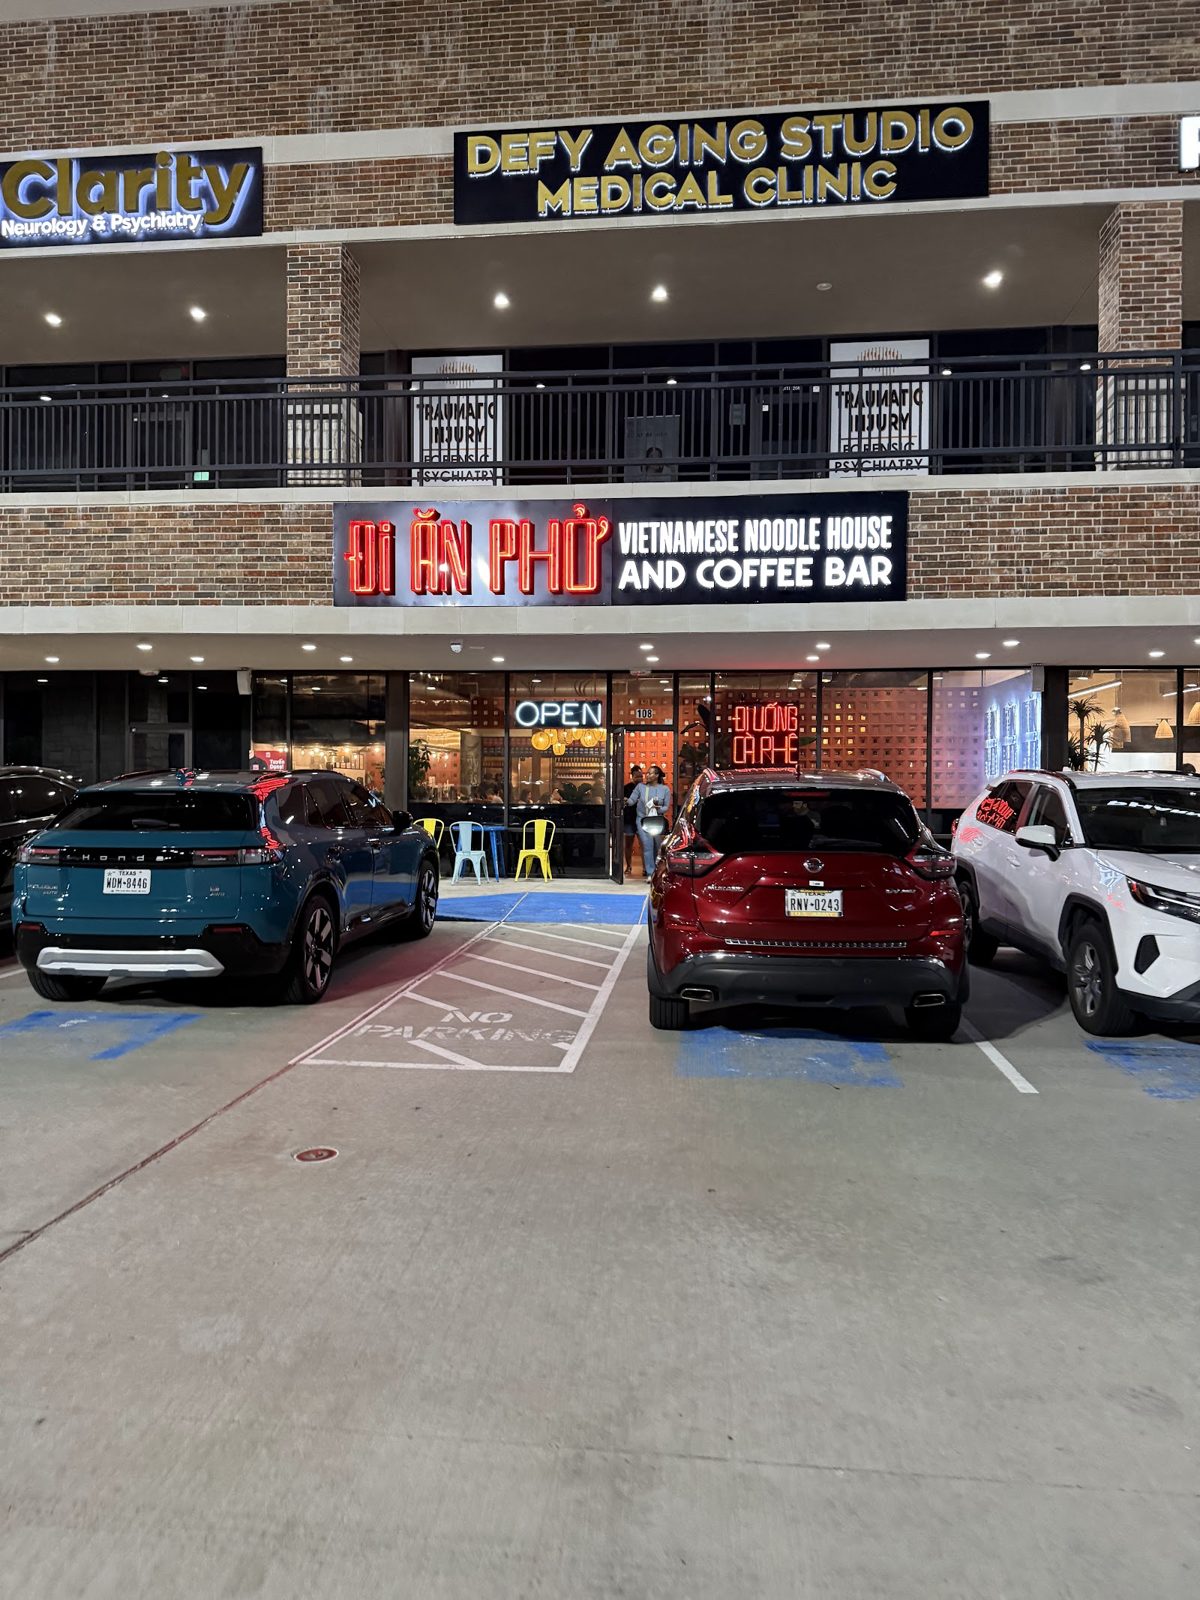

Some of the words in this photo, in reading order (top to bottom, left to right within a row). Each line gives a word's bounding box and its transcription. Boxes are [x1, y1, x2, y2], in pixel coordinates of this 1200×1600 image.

[467, 129, 593, 178] DEFY
[603, 119, 768, 170] AGING
[780, 106, 974, 161] STUDIO
[2, 151, 252, 226] Clarity
[537, 169, 734, 217] MEDICAL
[743, 160, 898, 207] CLINIC
[1, 218, 88, 238] Neurology
[92, 215, 106, 232] &
[111, 211, 201, 235] Psychiatry
[835, 388, 923, 408] TRAUMATC
[416, 402, 494, 421] TRAUMATC
[431, 426, 486, 443] NJURY
[425, 454, 490, 463] FORENSC
[843, 442, 915, 453] FORENSC
[835, 459, 923, 473] PSYCHIATRY
[618, 519, 739, 554] VIETNAMESE
[744, 517, 821, 552] NOODLE
[826, 515, 893, 550] HOUSE
[411, 507, 471, 596] ĂN
[489, 503, 613, 595] PHỞ
[618, 559, 686, 590] AND
[696, 557, 814, 589] COFFEE
[825, 554, 893, 587] BAR
[515, 701, 602, 727] OPEN
[637, 709, 652, 718] 108
[733, 732, 755, 764] CÀ
[440, 1011, 513, 1023] NO
[353, 1024, 578, 1043] PARKING
